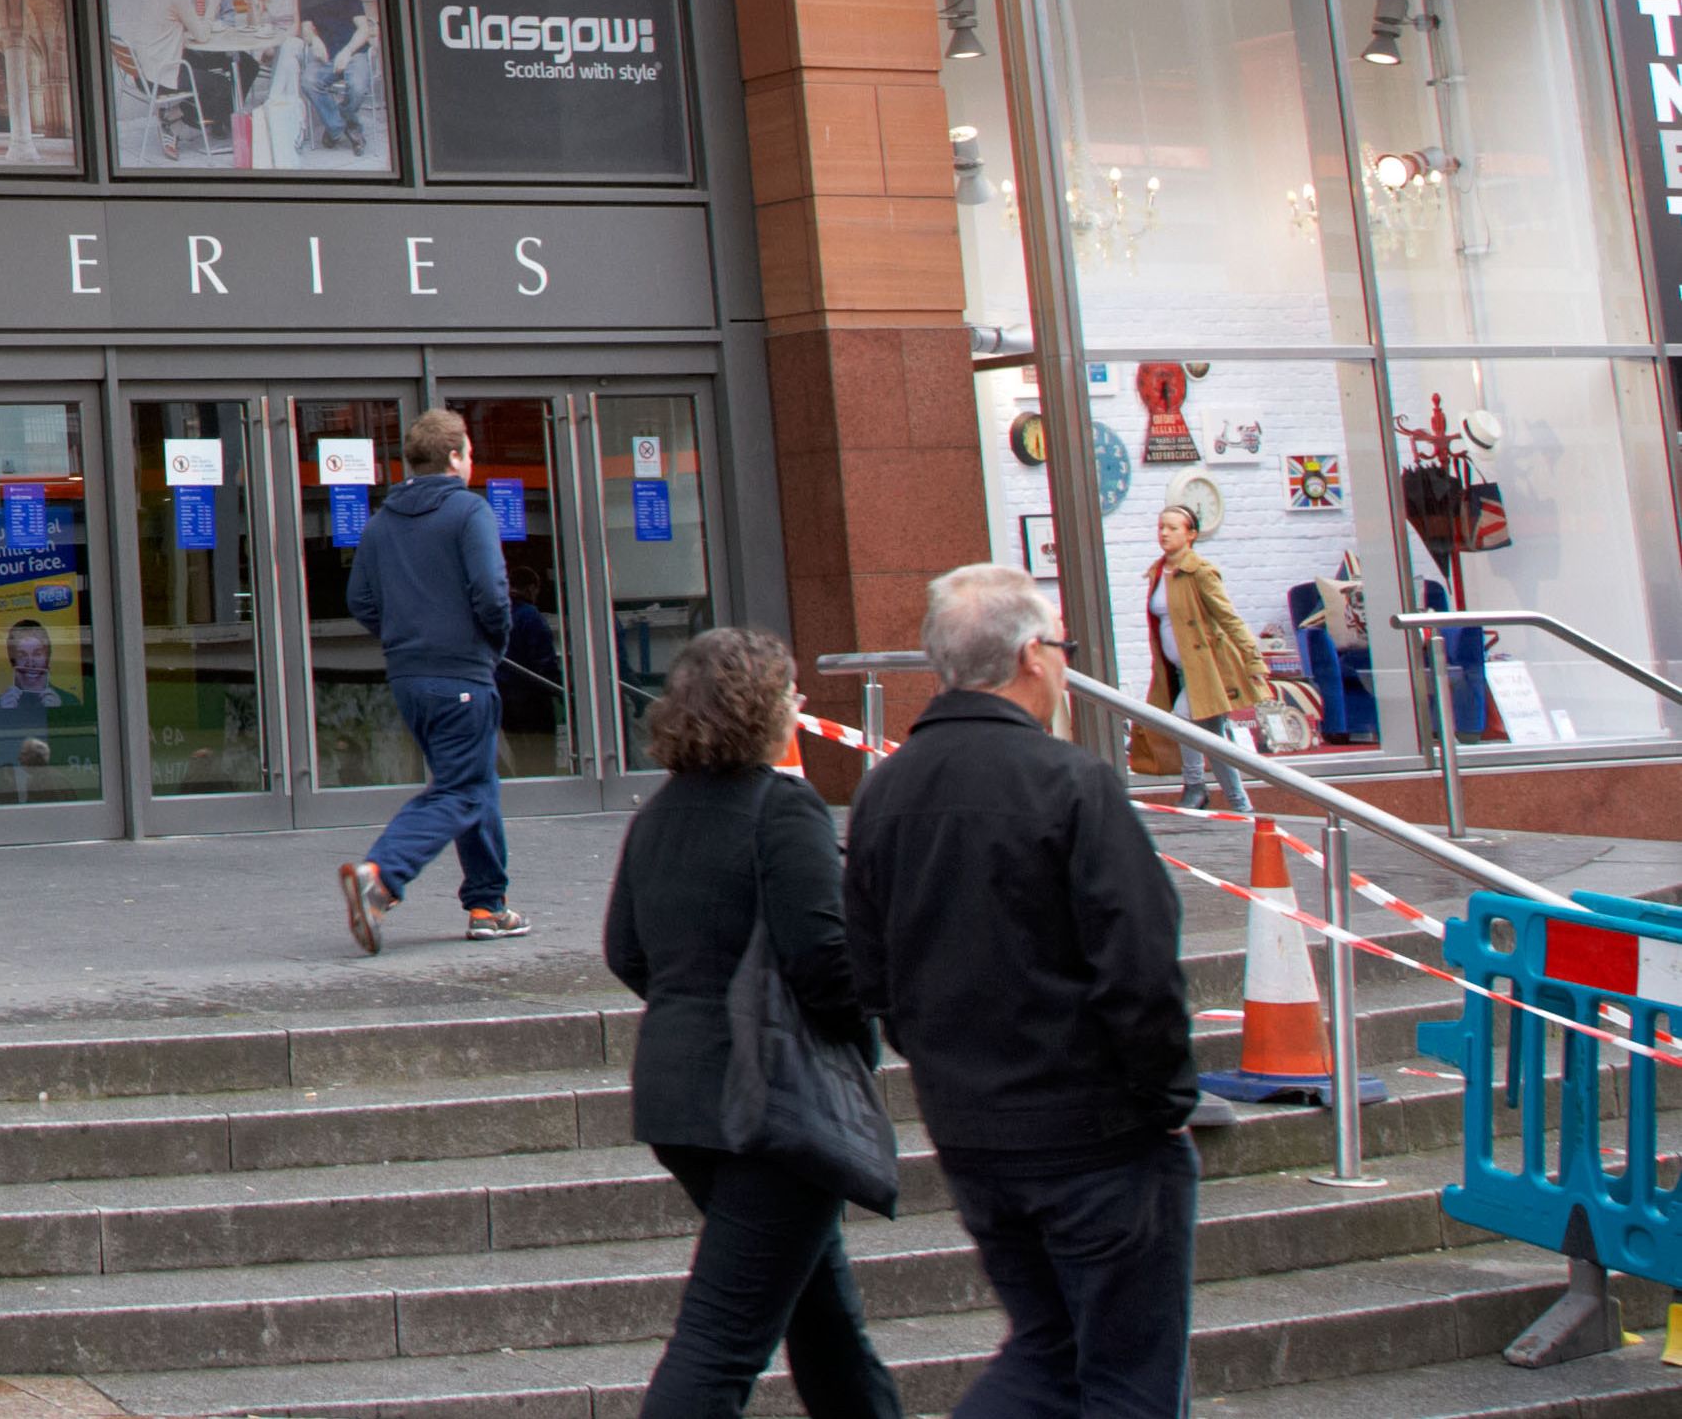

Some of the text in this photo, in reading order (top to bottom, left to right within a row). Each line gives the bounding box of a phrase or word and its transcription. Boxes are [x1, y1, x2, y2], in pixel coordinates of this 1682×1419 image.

[504, 60, 575, 79] Scotland
[578, 62, 615, 80] with
[28, 557, 67, 572] face.
